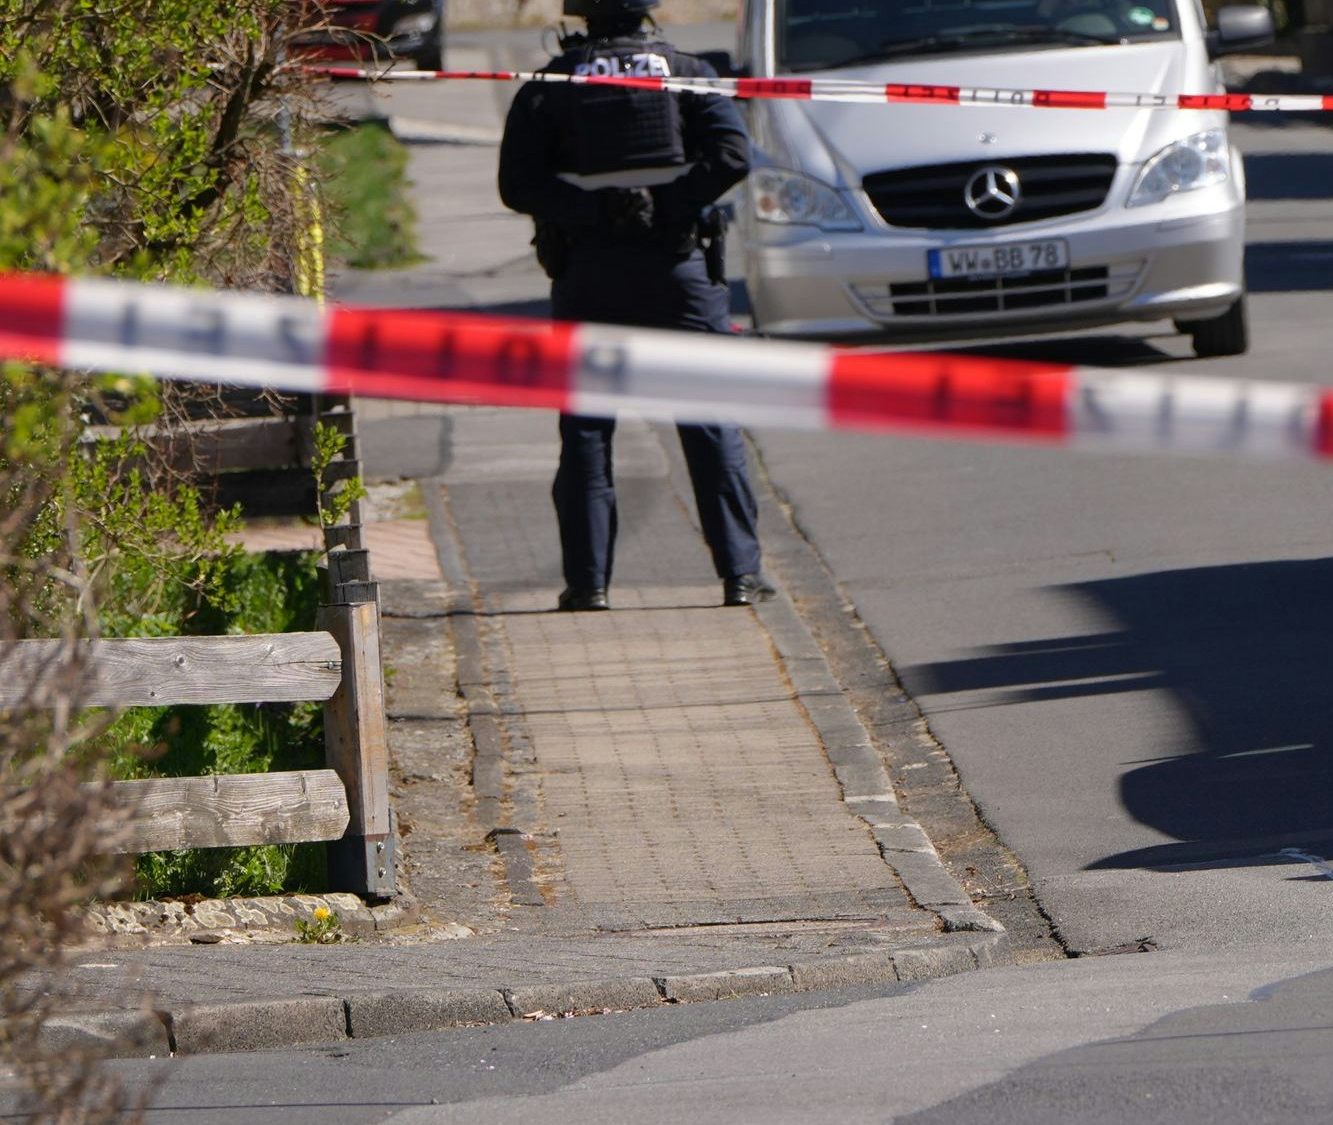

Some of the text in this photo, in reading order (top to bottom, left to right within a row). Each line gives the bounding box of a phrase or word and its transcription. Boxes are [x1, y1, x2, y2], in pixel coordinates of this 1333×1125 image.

[575, 53, 671, 78] POLIZEI
[949, 244, 1059, 272] WW BB 78
